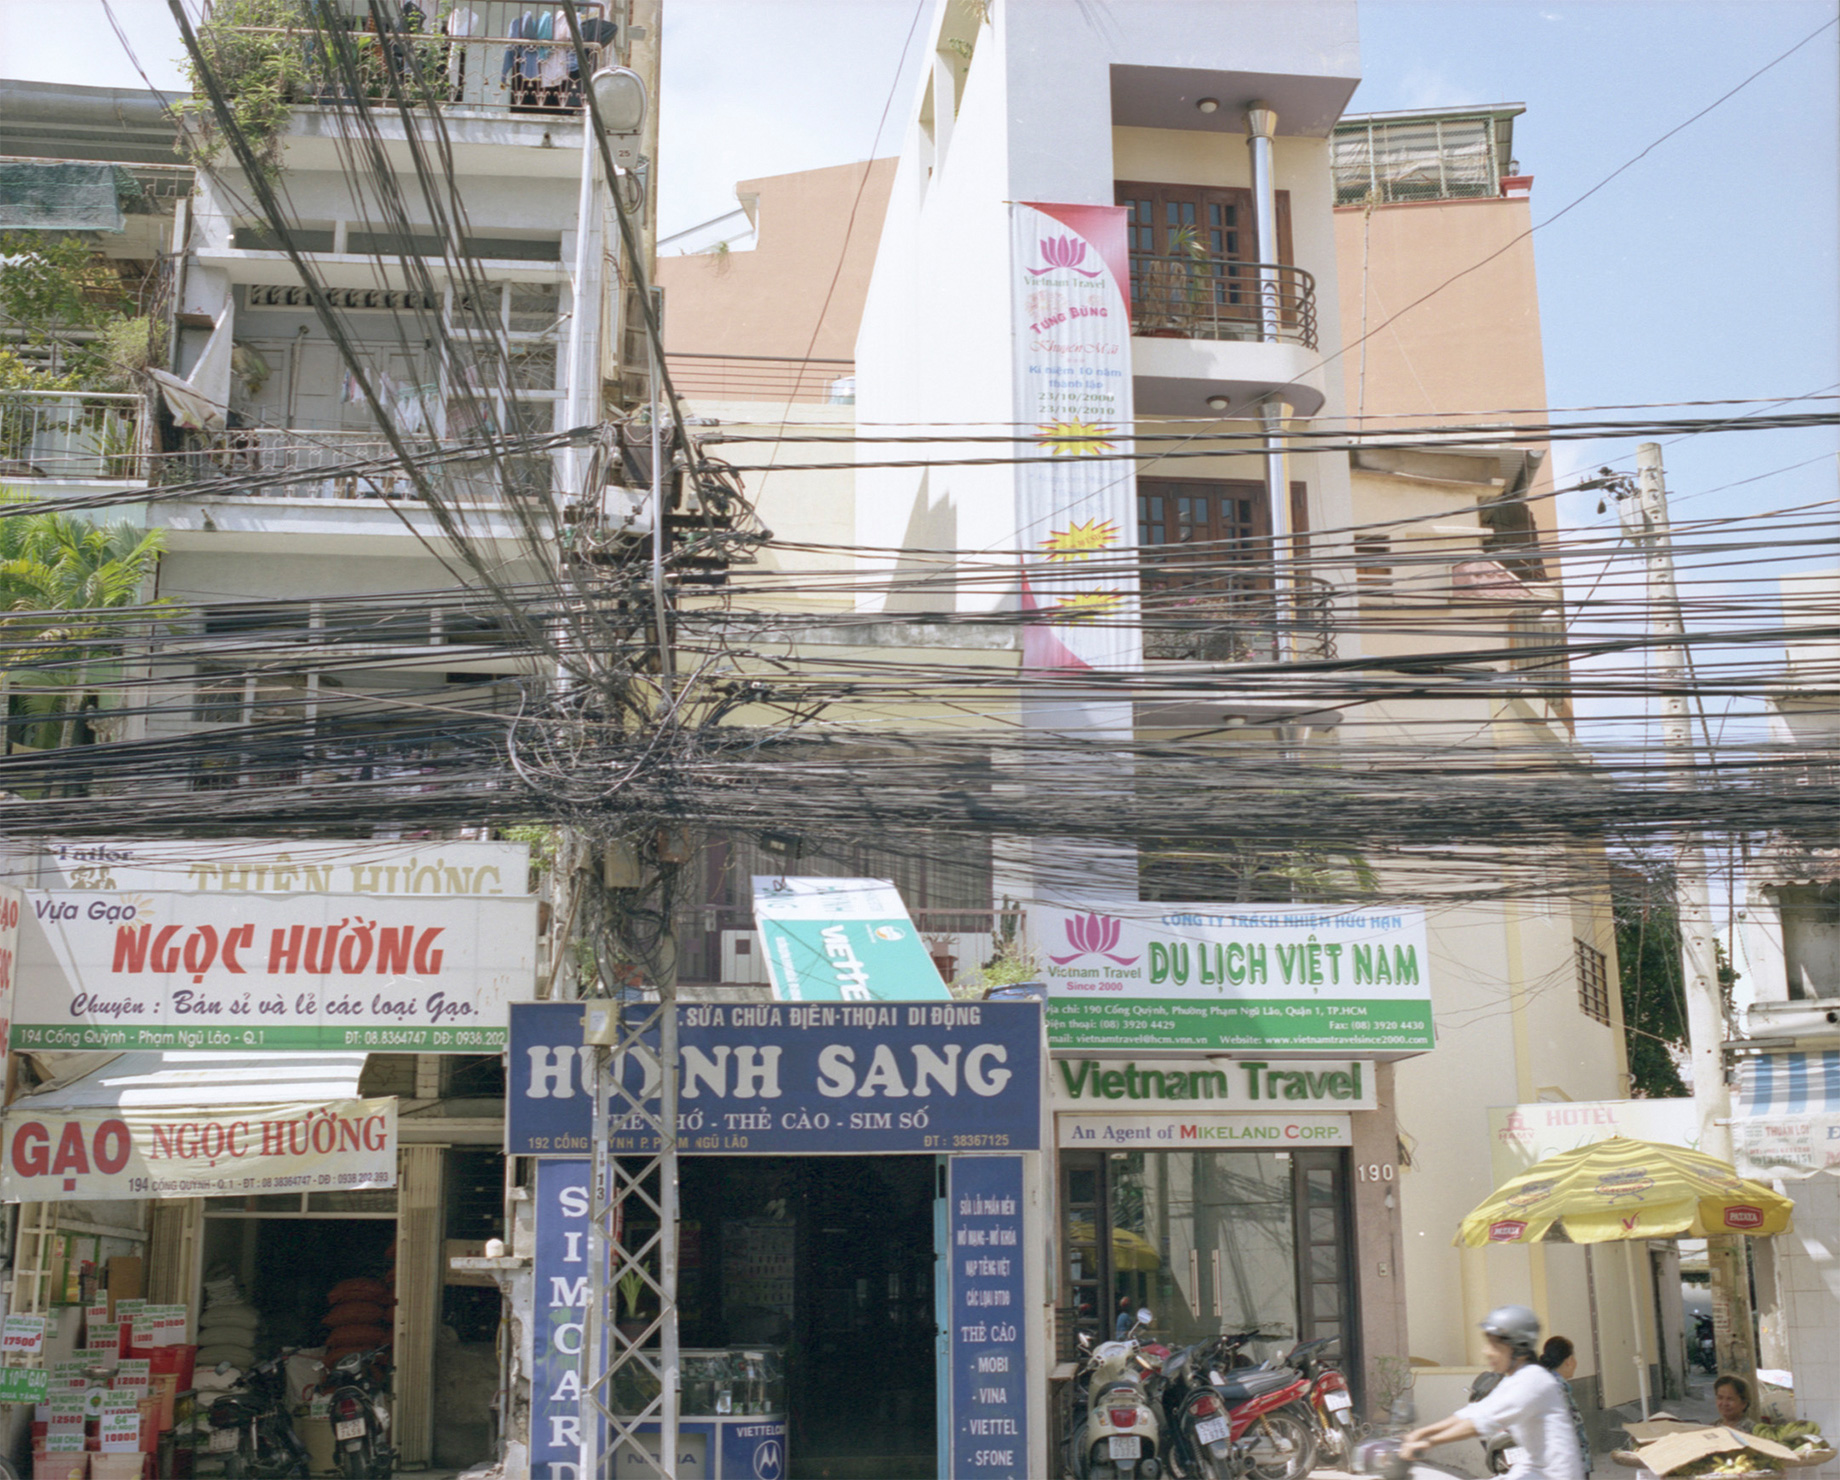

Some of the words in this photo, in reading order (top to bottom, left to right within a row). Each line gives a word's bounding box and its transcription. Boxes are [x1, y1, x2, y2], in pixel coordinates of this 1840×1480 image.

[35, 900, 79, 924] Vựa
[87, 901, 137, 924] Gạo
[1208, 914, 1223, 927] TY
[111, 924, 255, 984] NGỌC
[267, 916, 446, 975] HƯỜNG
[1047, 966, 1100, 979] Vietnam
[1103, 966, 1142, 979] Travel
[1148, 941, 1190, 986] DU
[1197, 942, 1267, 993] LỊCH
[1275, 934, 1343, 994] VIỆT
[1351, 943, 1420, 986] NAM
[1066, 981, 1096, 991] Since
[1098, 981, 1124, 991] 2000
[70, 992, 145, 1018] Chuyên
[172, 990, 223, 1014] Bán
[258, 994, 287, 1015] và
[326, 995, 363, 1015] các
[372, 994, 417, 1021] loại
[426, 991, 479, 1023] Gạo.
[1084, 1005, 1102, 1014] 190
[1104, 1004, 1130, 1016] Cống
[1327, 1006, 1368, 1016] TP.HCM
[732, 1003, 783, 1027] CHỮA
[908, 1006, 926, 1026] DI
[931, 1004, 981, 1031] ĐỘNG
[1099, 1020, 1120, 1030] (08)
[1123, 1020, 1148, 1029] 3920
[1151, 1020, 1175, 1029] 4429
[1329, 1021, 1349, 1030] Fax:
[1351, 1021, 1371, 1031] (08)
[1374, 1021, 1398, 1030] 3920
[1400, 1021, 1424, 1030] 4430
[21, 1029, 41, 1043] 194
[45, 1027, 79, 1045] Cống
[84, 1029, 126, 1046] Quỳnh
[138, 1030, 175, 1046] Phạm
[178, 1030, 204, 1047] Ngũ
[208, 1030, 231, 1044] Lão
[243, 1031, 264, 1045] Q.1
[1219, 1035, 1262, 1044] Website:
[817, 1043, 1012, 1098] SANG
[1058, 1060, 1228, 1100] Vietnam
[1238, 1061, 1362, 1100] Travel
[724, 1106, 772, 1130] THẺ
[781, 1107, 830, 1129] CÀO
[850, 1113, 892, 1129] SIM
[899, 1105, 930, 1129] SỐ
[1546, 1107, 1619, 1127] HOTEL
[528, 1136, 549, 1149] 192
[554, 1132, 588, 1149] CỐNG
[725, 1133, 748, 1148] LÃO
[953, 1134, 1009, 1147] 38367125
[1072, 1125, 1096, 1139] An
[1103, 1125, 1152, 1143] Agent
[1157, 1125, 1175, 1139] of
[1180, 1125, 1280, 1139] MIKELAND
[1285, 1125, 1342, 1139] CORP.
[11, 1119, 131, 1191] GẠO
[150, 1121, 249, 1167] NGỌC
[259, 1107, 388, 1156] HƯỜNG
[1358, 1164, 1393, 1182] 190
[128, 1177, 148, 1191] 194
[961, 1320, 987, 1342] THẺ
[991, 1321, 1017, 1342] CÀO
[978, 1357, 1009, 1373] MOBI
[979, 1388, 1007, 1404] VINA
[970, 1419, 1019, 1435] VIETTEL
[975, 1450, 1014, 1466] SFONE
